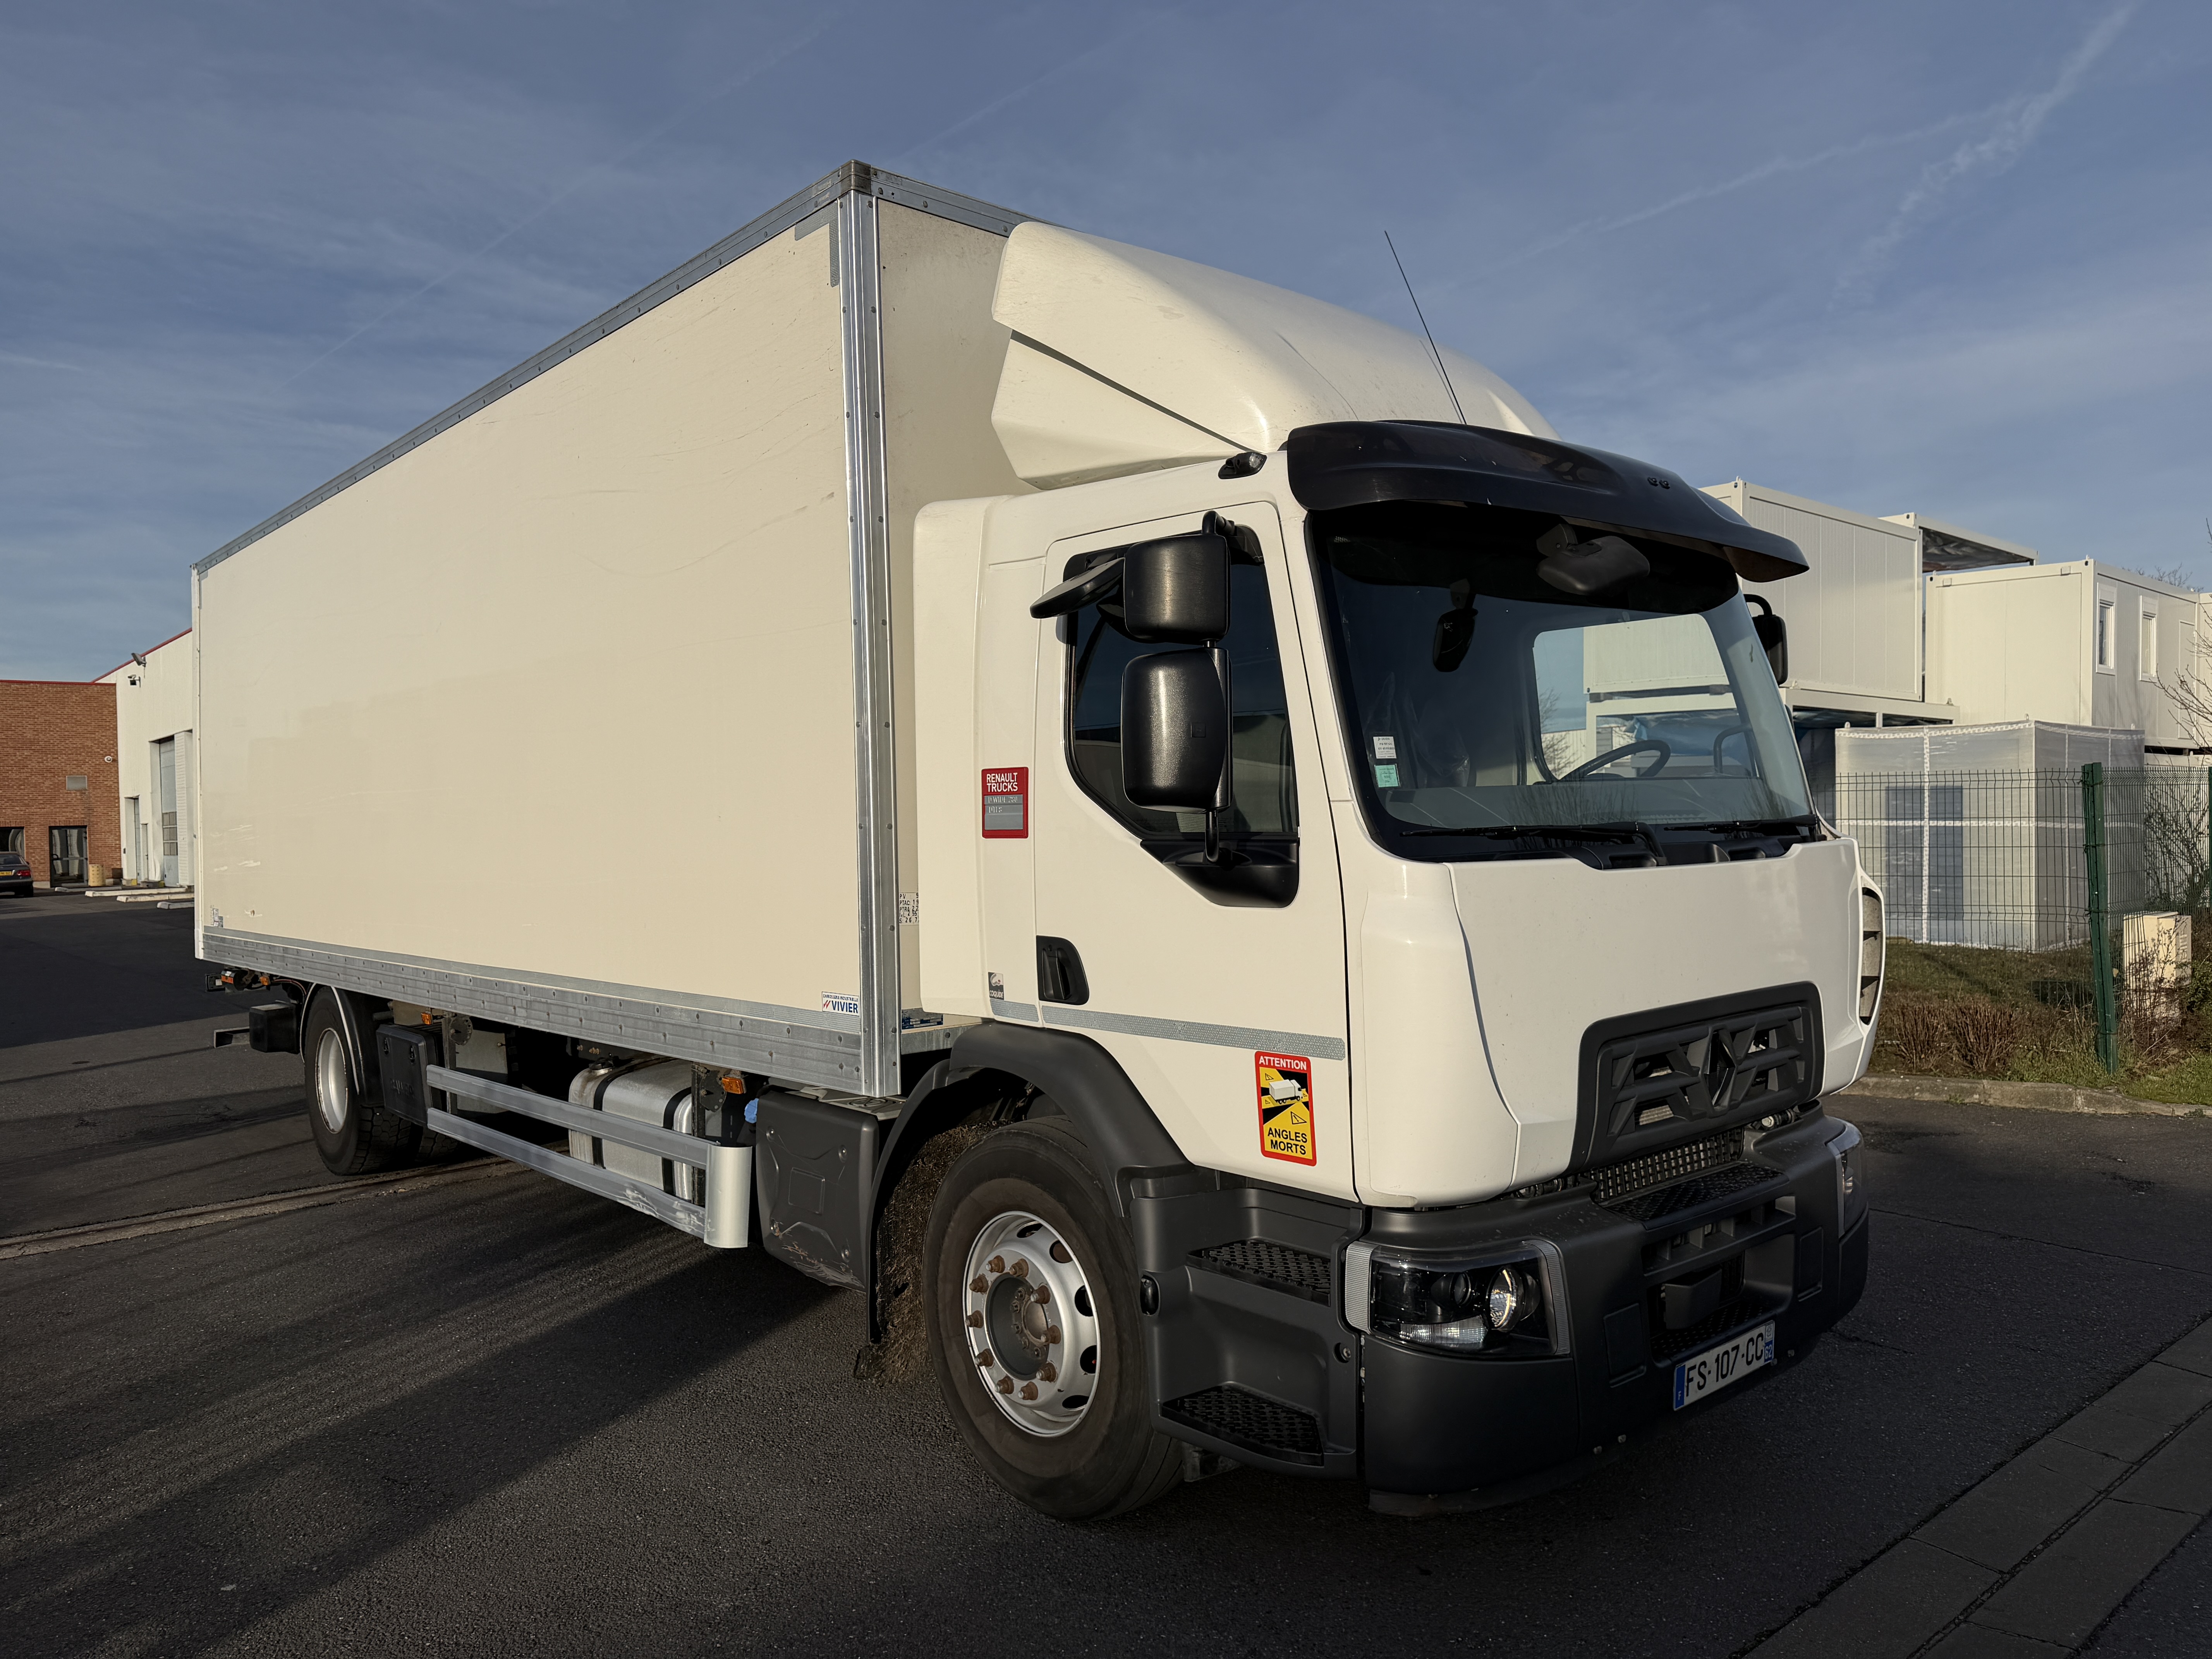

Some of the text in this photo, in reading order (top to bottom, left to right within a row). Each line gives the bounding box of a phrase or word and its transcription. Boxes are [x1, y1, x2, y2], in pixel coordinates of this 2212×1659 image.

[987, 772, 1018, 783] RENAULT
[987, 782, 1018, 792] TRUCKS
[831, 1000, 858, 1013] VIVIER
[1259, 1056, 1307, 1070] ATTENTION
[1267, 1127, 1307, 1143] ANGLES
[1271, 1140, 1306, 1155] MORTS
[1678, 1332, 1772, 1400] F FS-107-CC 62
